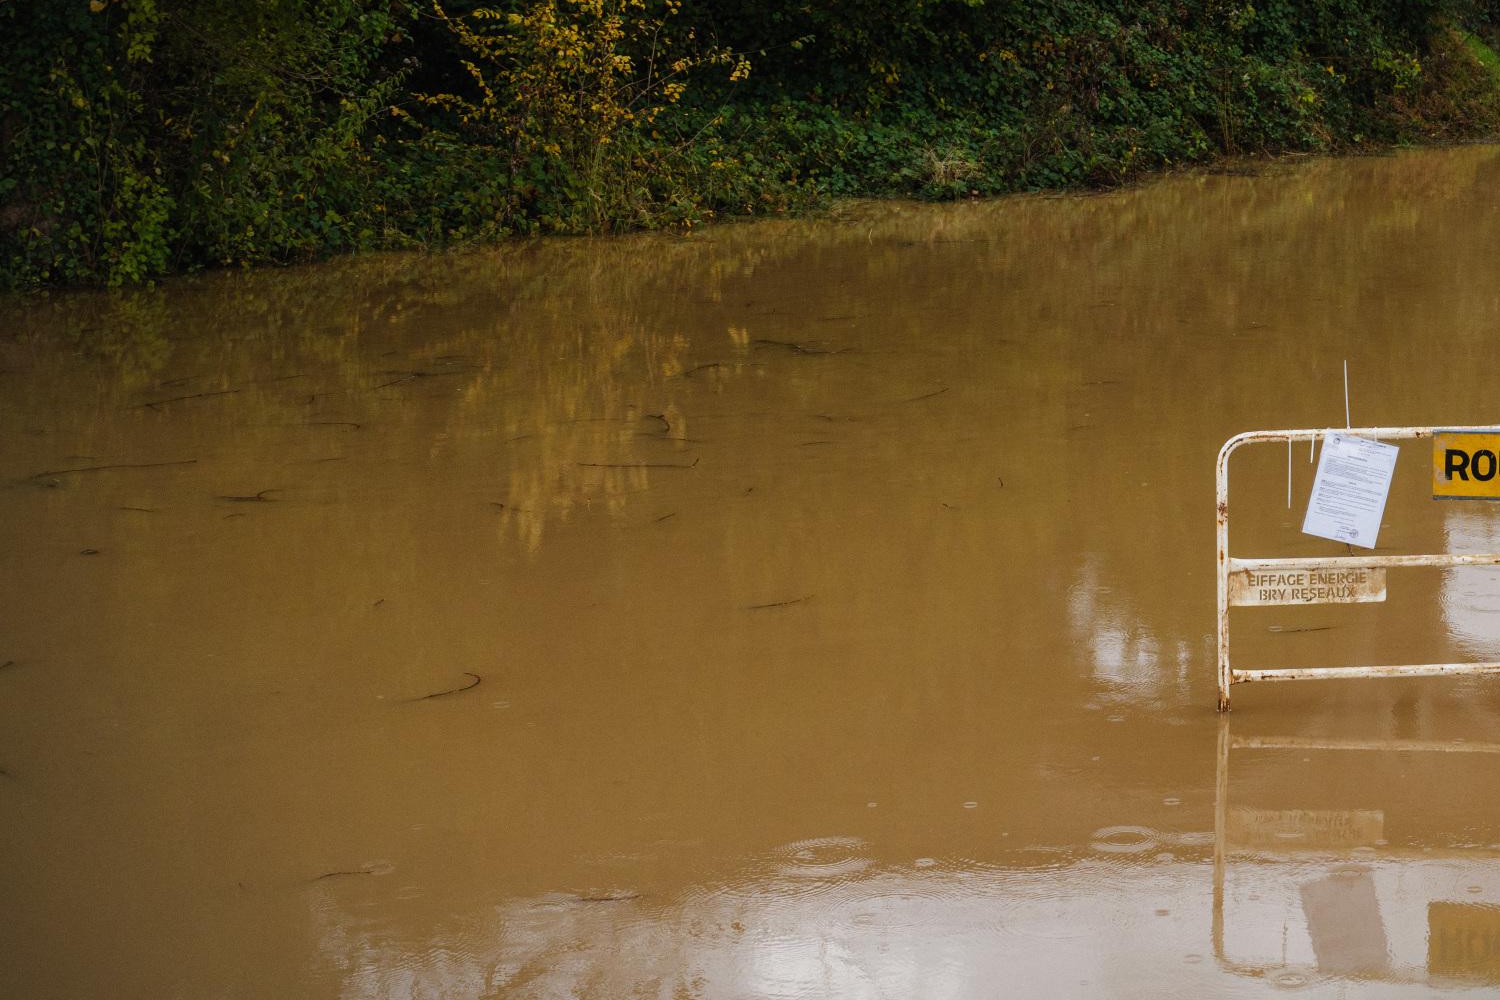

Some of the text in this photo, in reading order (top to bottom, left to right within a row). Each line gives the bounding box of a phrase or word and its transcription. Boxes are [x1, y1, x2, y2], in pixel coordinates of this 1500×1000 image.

[1248, 572, 1366, 587] EIFFAGE ENERGIE
[1259, 586, 1356, 600] BRY RESEAUX
